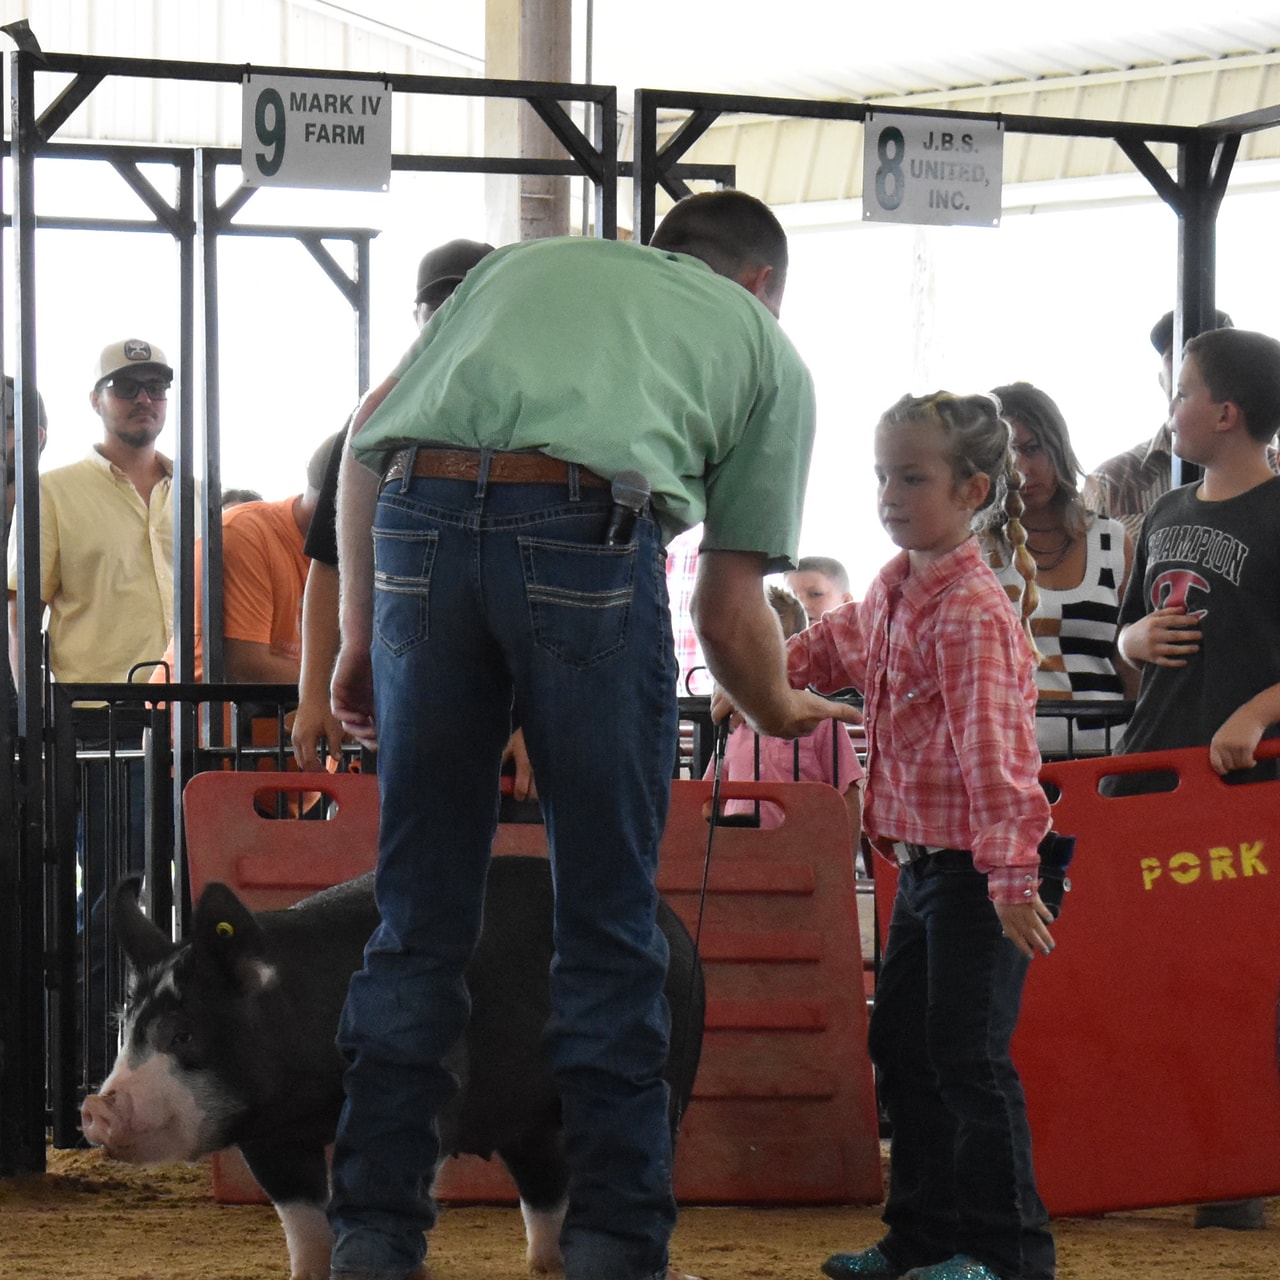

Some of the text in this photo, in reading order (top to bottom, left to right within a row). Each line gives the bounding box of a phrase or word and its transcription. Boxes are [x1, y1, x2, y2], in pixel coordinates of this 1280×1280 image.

[289, 92, 382, 115] MARK IV
[254, 87, 286, 177] 9
[305, 123, 365, 145] FARM
[923, 131, 979, 154] J.B.S.
[875, 126, 905, 211] 8
[910, 159, 990, 187] UNITED,
[928, 189, 970, 211] INC.
[1140, 841, 1268, 891] PORK
